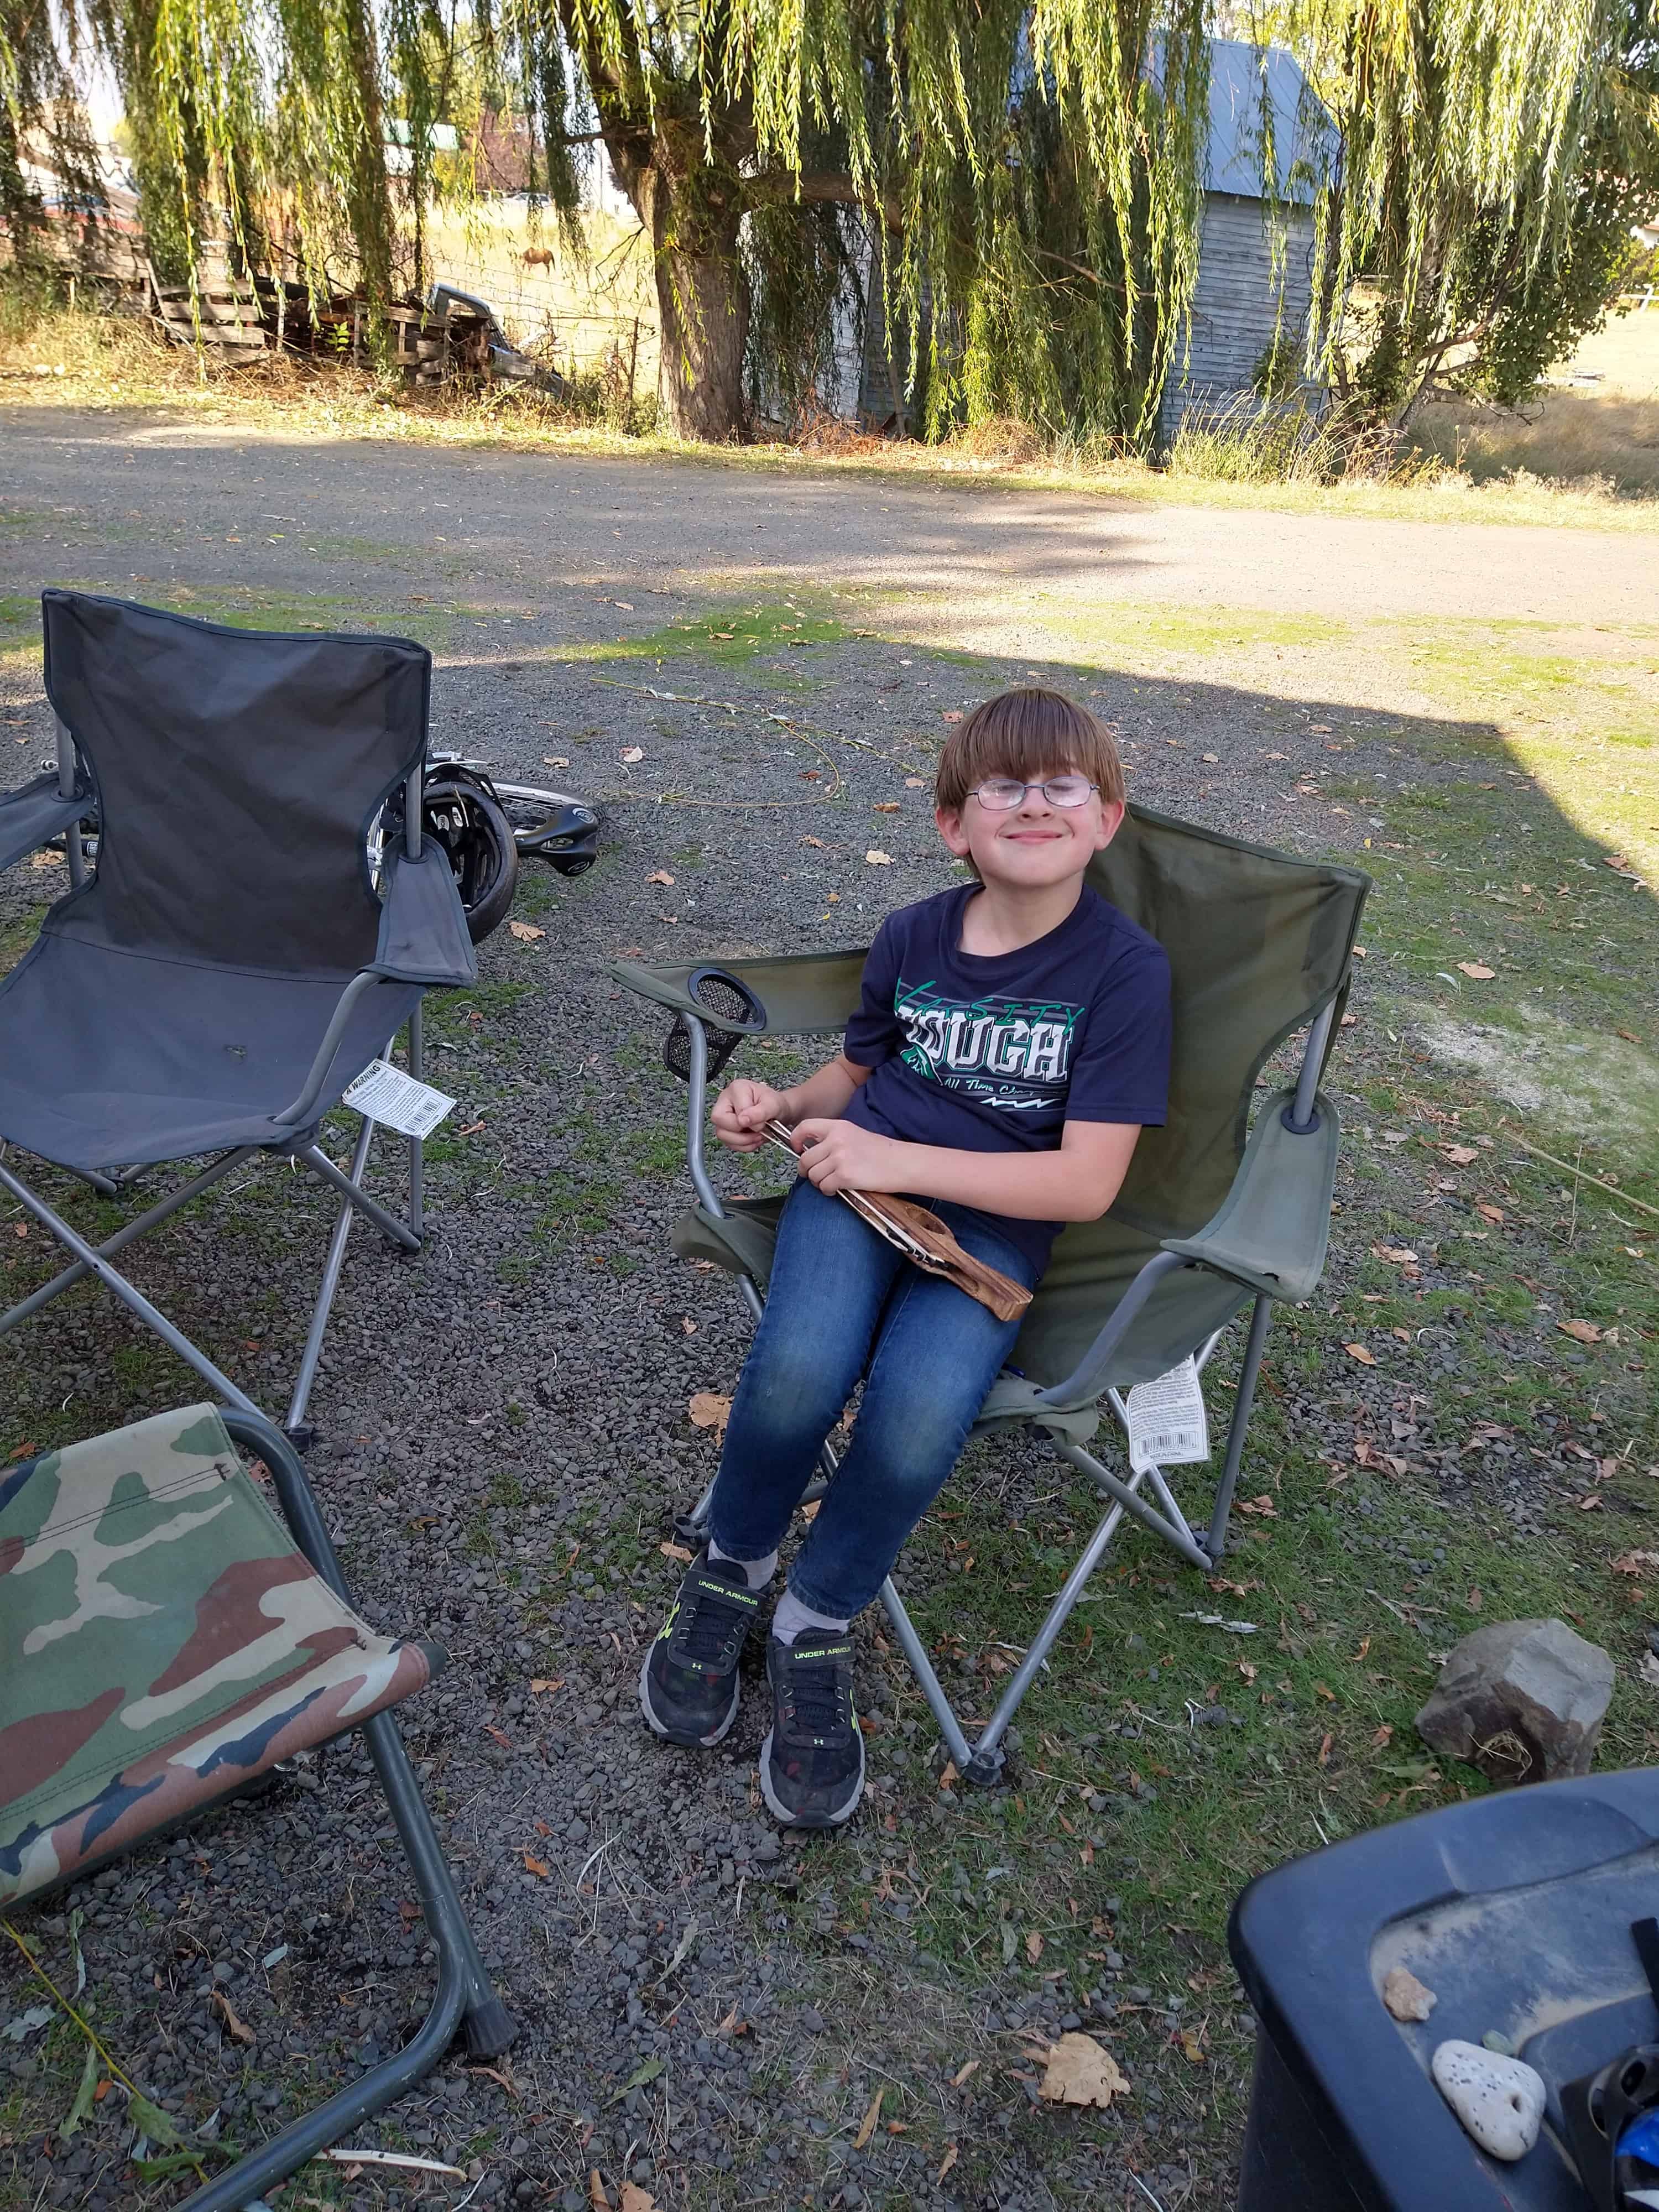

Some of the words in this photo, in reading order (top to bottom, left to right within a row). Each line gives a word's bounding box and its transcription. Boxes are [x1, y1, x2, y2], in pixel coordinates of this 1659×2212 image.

[894, 1004, 1074, 1082] TOUGH
[352, 1065, 380, 1091] WARNING
[945, 1078, 959, 1089] All
[966, 1079, 994, 1092] Time
[698, 1579, 724, 1594] UNDER
[725, 1590, 758, 1606] ARMOUR
[795, 1650, 825, 1659] UNDER
[827, 1646, 851, 1655] ARMOUR
